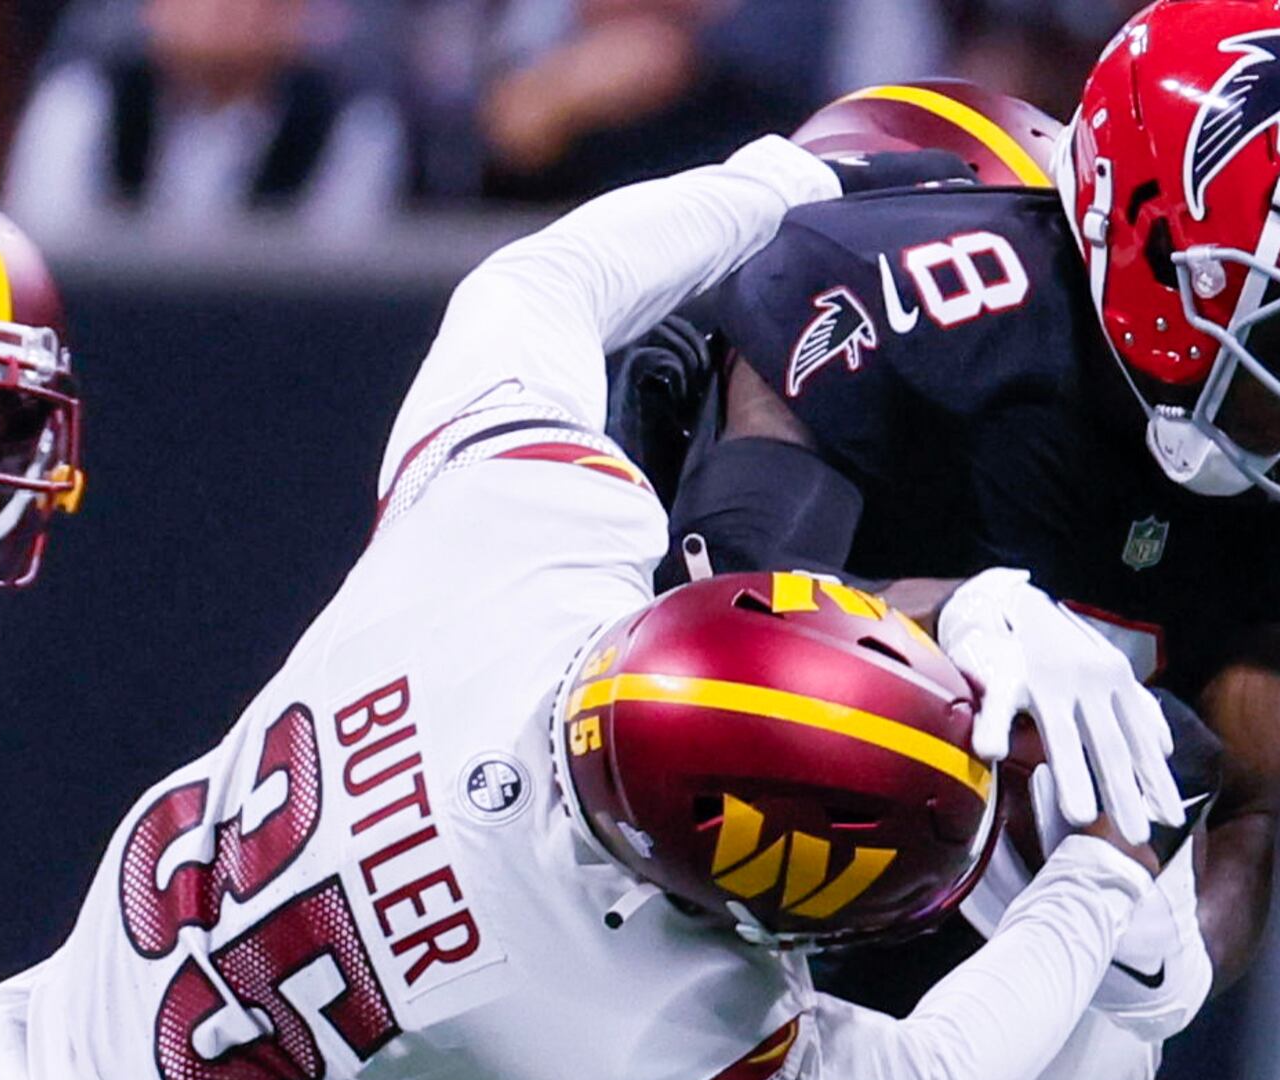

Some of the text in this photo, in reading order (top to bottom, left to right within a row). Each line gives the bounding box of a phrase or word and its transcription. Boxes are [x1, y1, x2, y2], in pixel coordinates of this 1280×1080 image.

[901, 230, 1030, 331] 8
[333, 674, 481, 988] BUTLER
[710, 792, 898, 919] W
